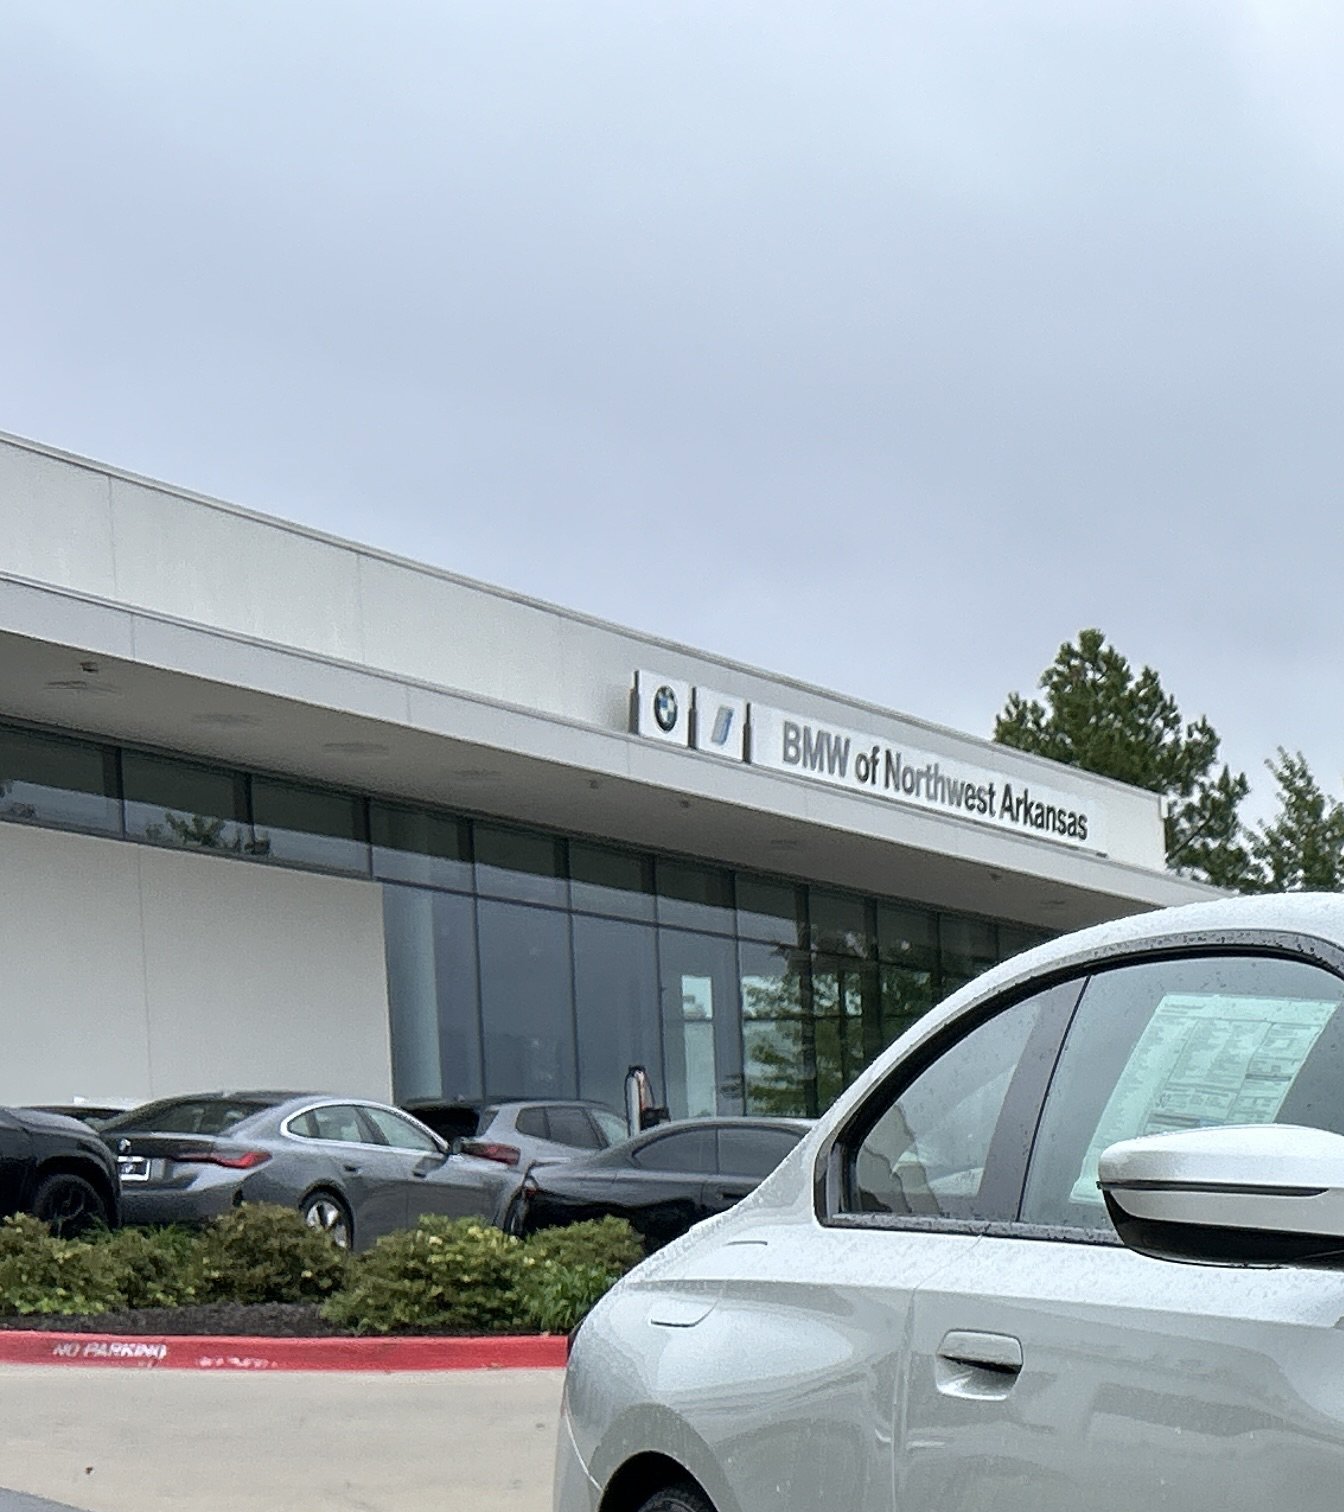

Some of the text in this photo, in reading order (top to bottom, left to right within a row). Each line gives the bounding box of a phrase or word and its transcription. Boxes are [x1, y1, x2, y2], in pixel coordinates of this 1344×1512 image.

[783, 721, 1088, 840] BMW of Northwest Arkansas
[53, 1343, 80, 1357] NO
